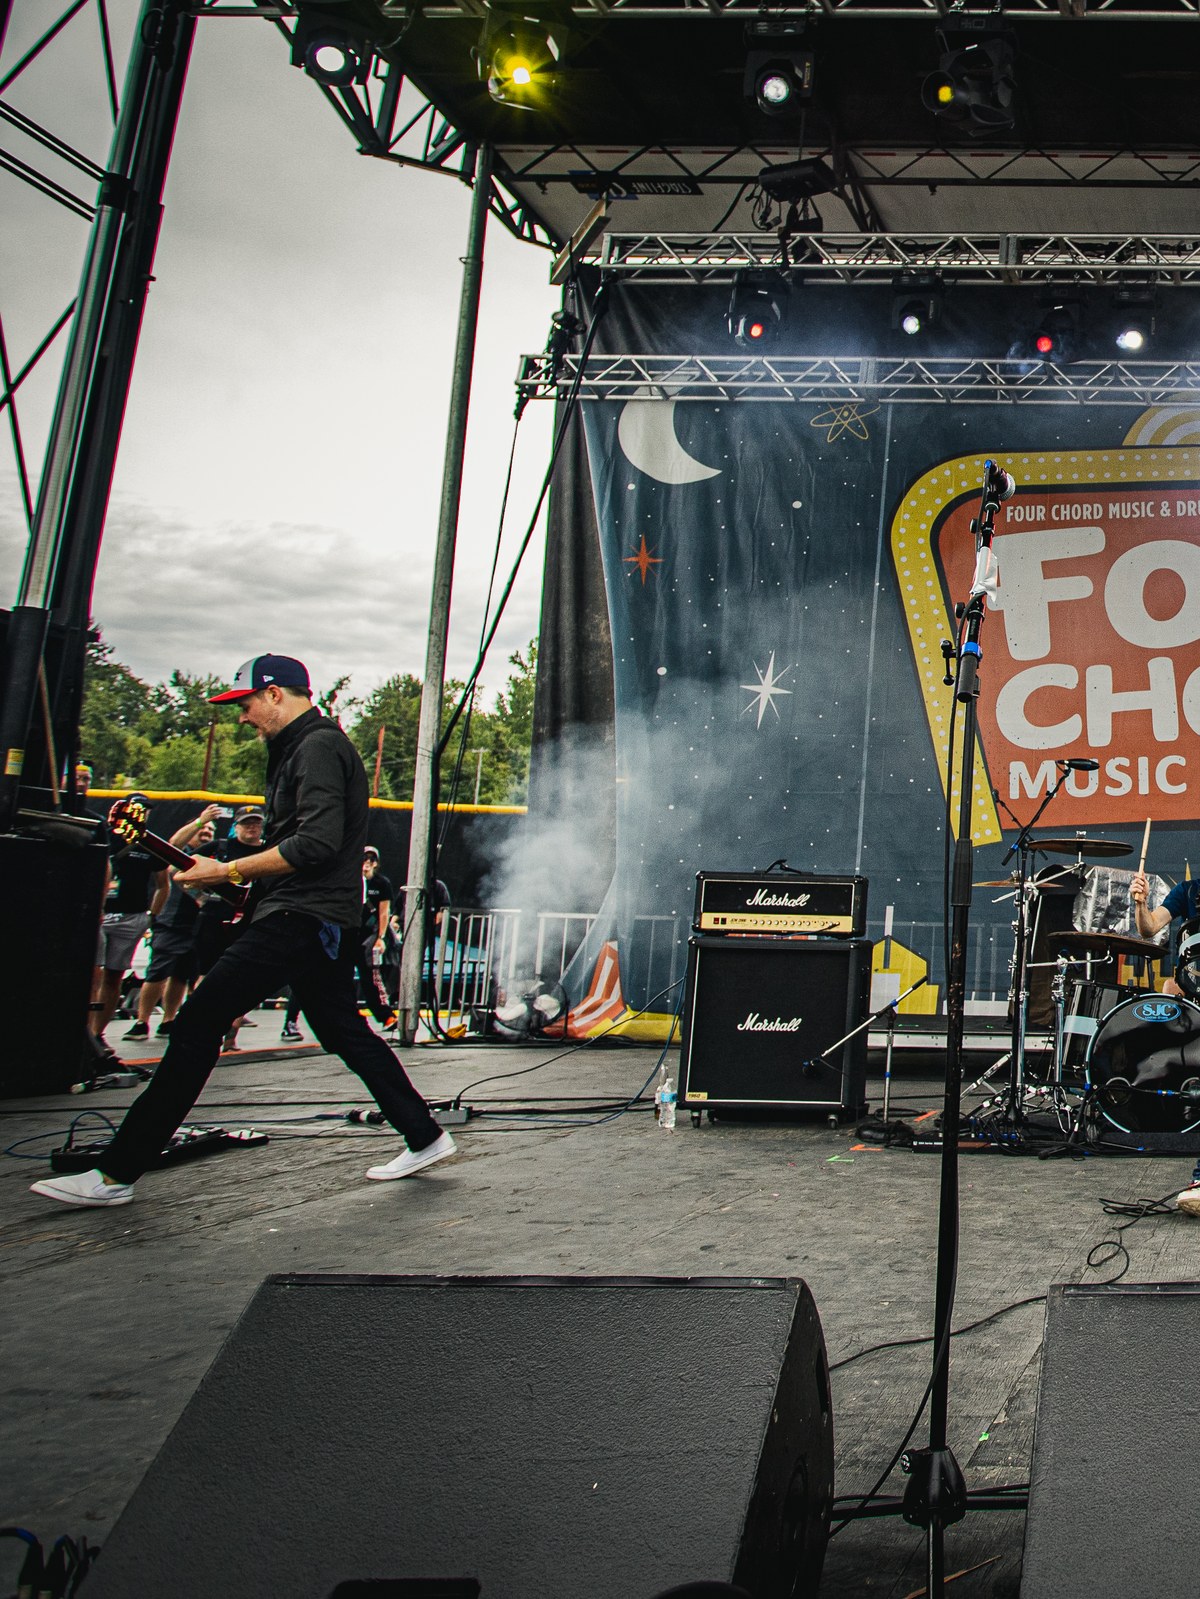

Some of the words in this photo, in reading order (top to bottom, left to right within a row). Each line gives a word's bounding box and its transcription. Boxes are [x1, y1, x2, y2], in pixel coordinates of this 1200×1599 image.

[1006, 505, 1046, 523] FOUR
[1051, 503, 1103, 521] CHORD
[1108, 501, 1155, 519] MUSIC
[1159, 500, 1171, 517] &
[1009, 755, 1187, 800] MUSIC
[746, 888, 811, 907] Marshall
[1142, 1003, 1171, 1017] SJC
[737, 1012, 802, 1032] Marshall
